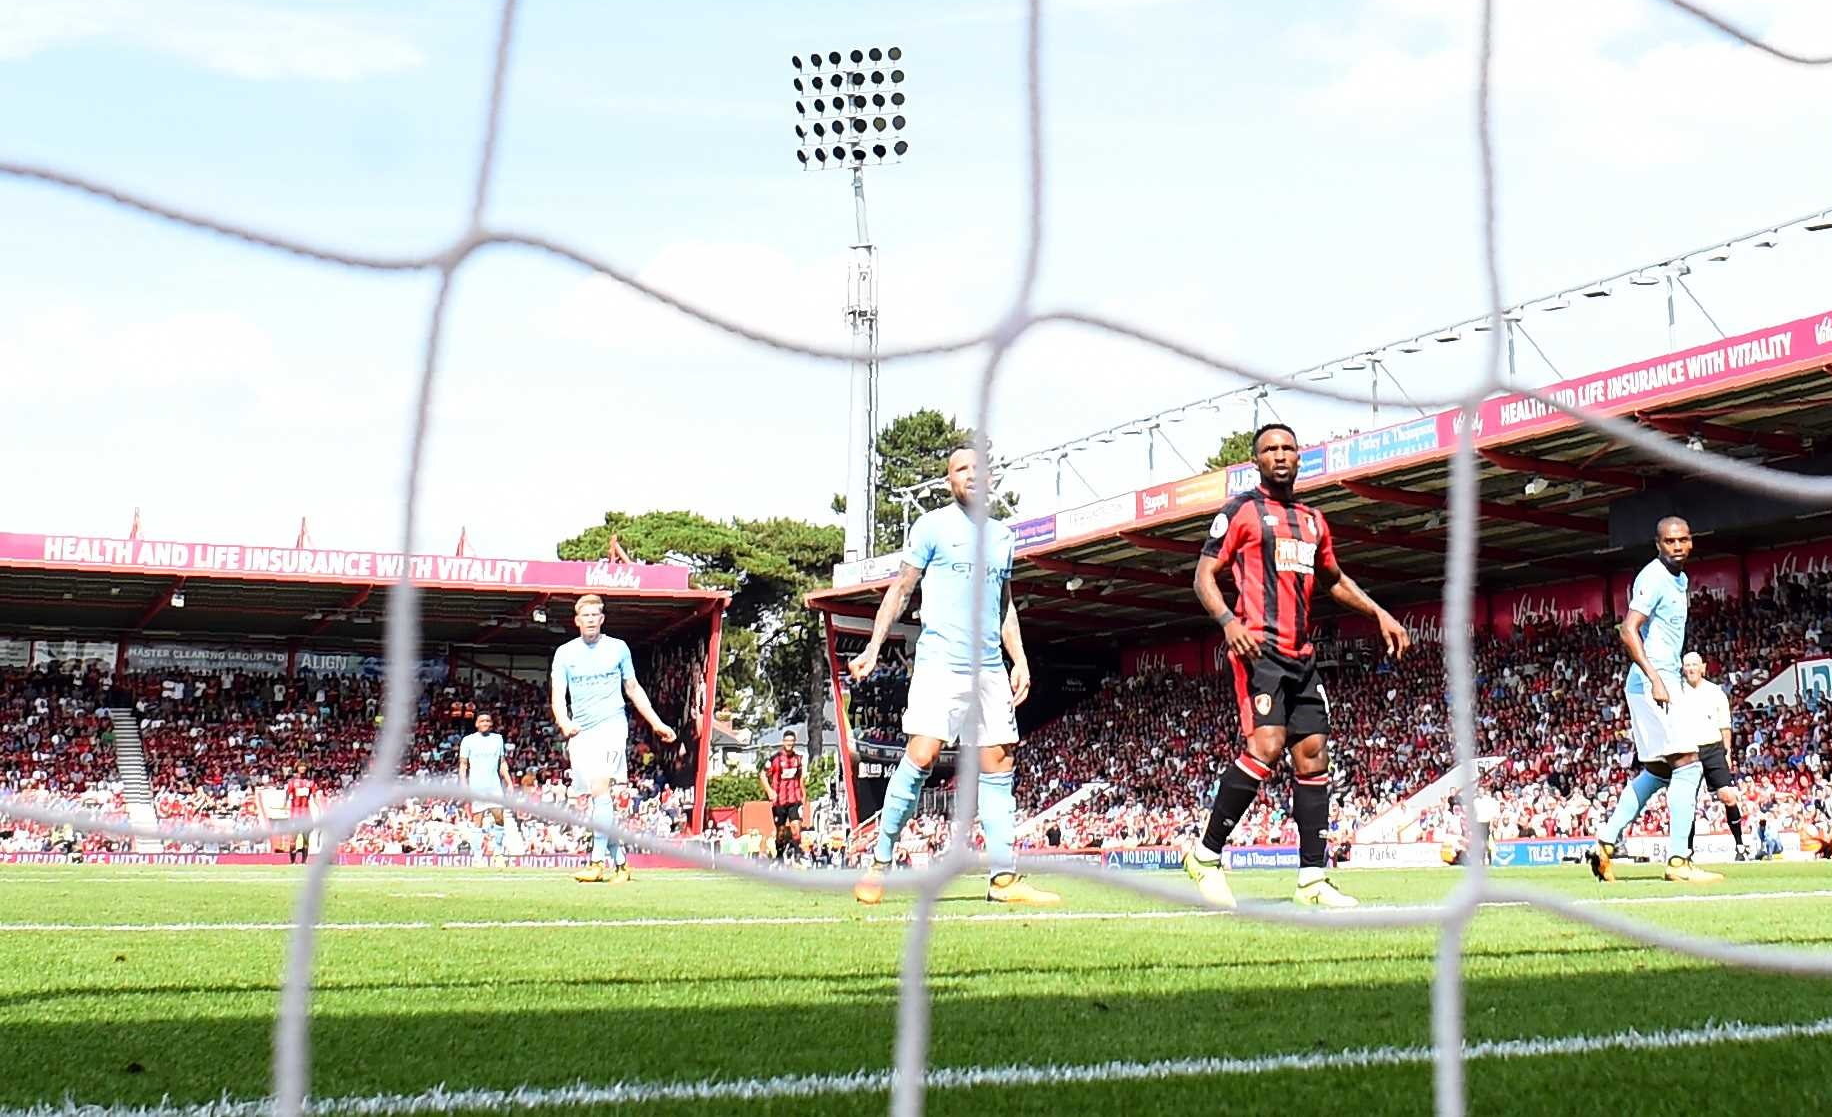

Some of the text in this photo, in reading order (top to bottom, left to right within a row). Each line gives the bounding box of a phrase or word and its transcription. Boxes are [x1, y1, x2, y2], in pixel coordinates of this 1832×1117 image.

[1501, 397, 1549, 427] HEALTH
[1577, 379, 1606, 408] LIFE
[1607, 360, 1686, 400] INSURANCE
[1686, 348, 1726, 380] WITH
[1726, 331, 1793, 370] VITALITY
[43, 535, 134, 565] HEALTH
[136, 541, 190, 568] AND
[193, 544, 241, 570] LIFE
[245, 547, 371, 576] INSURANCE
[437, 556, 528, 584] VITALITY
[128, 648, 171, 659] MASTER
[300, 654, 349, 671] ALIGN
[1122, 850, 1162, 865] HORIZON
